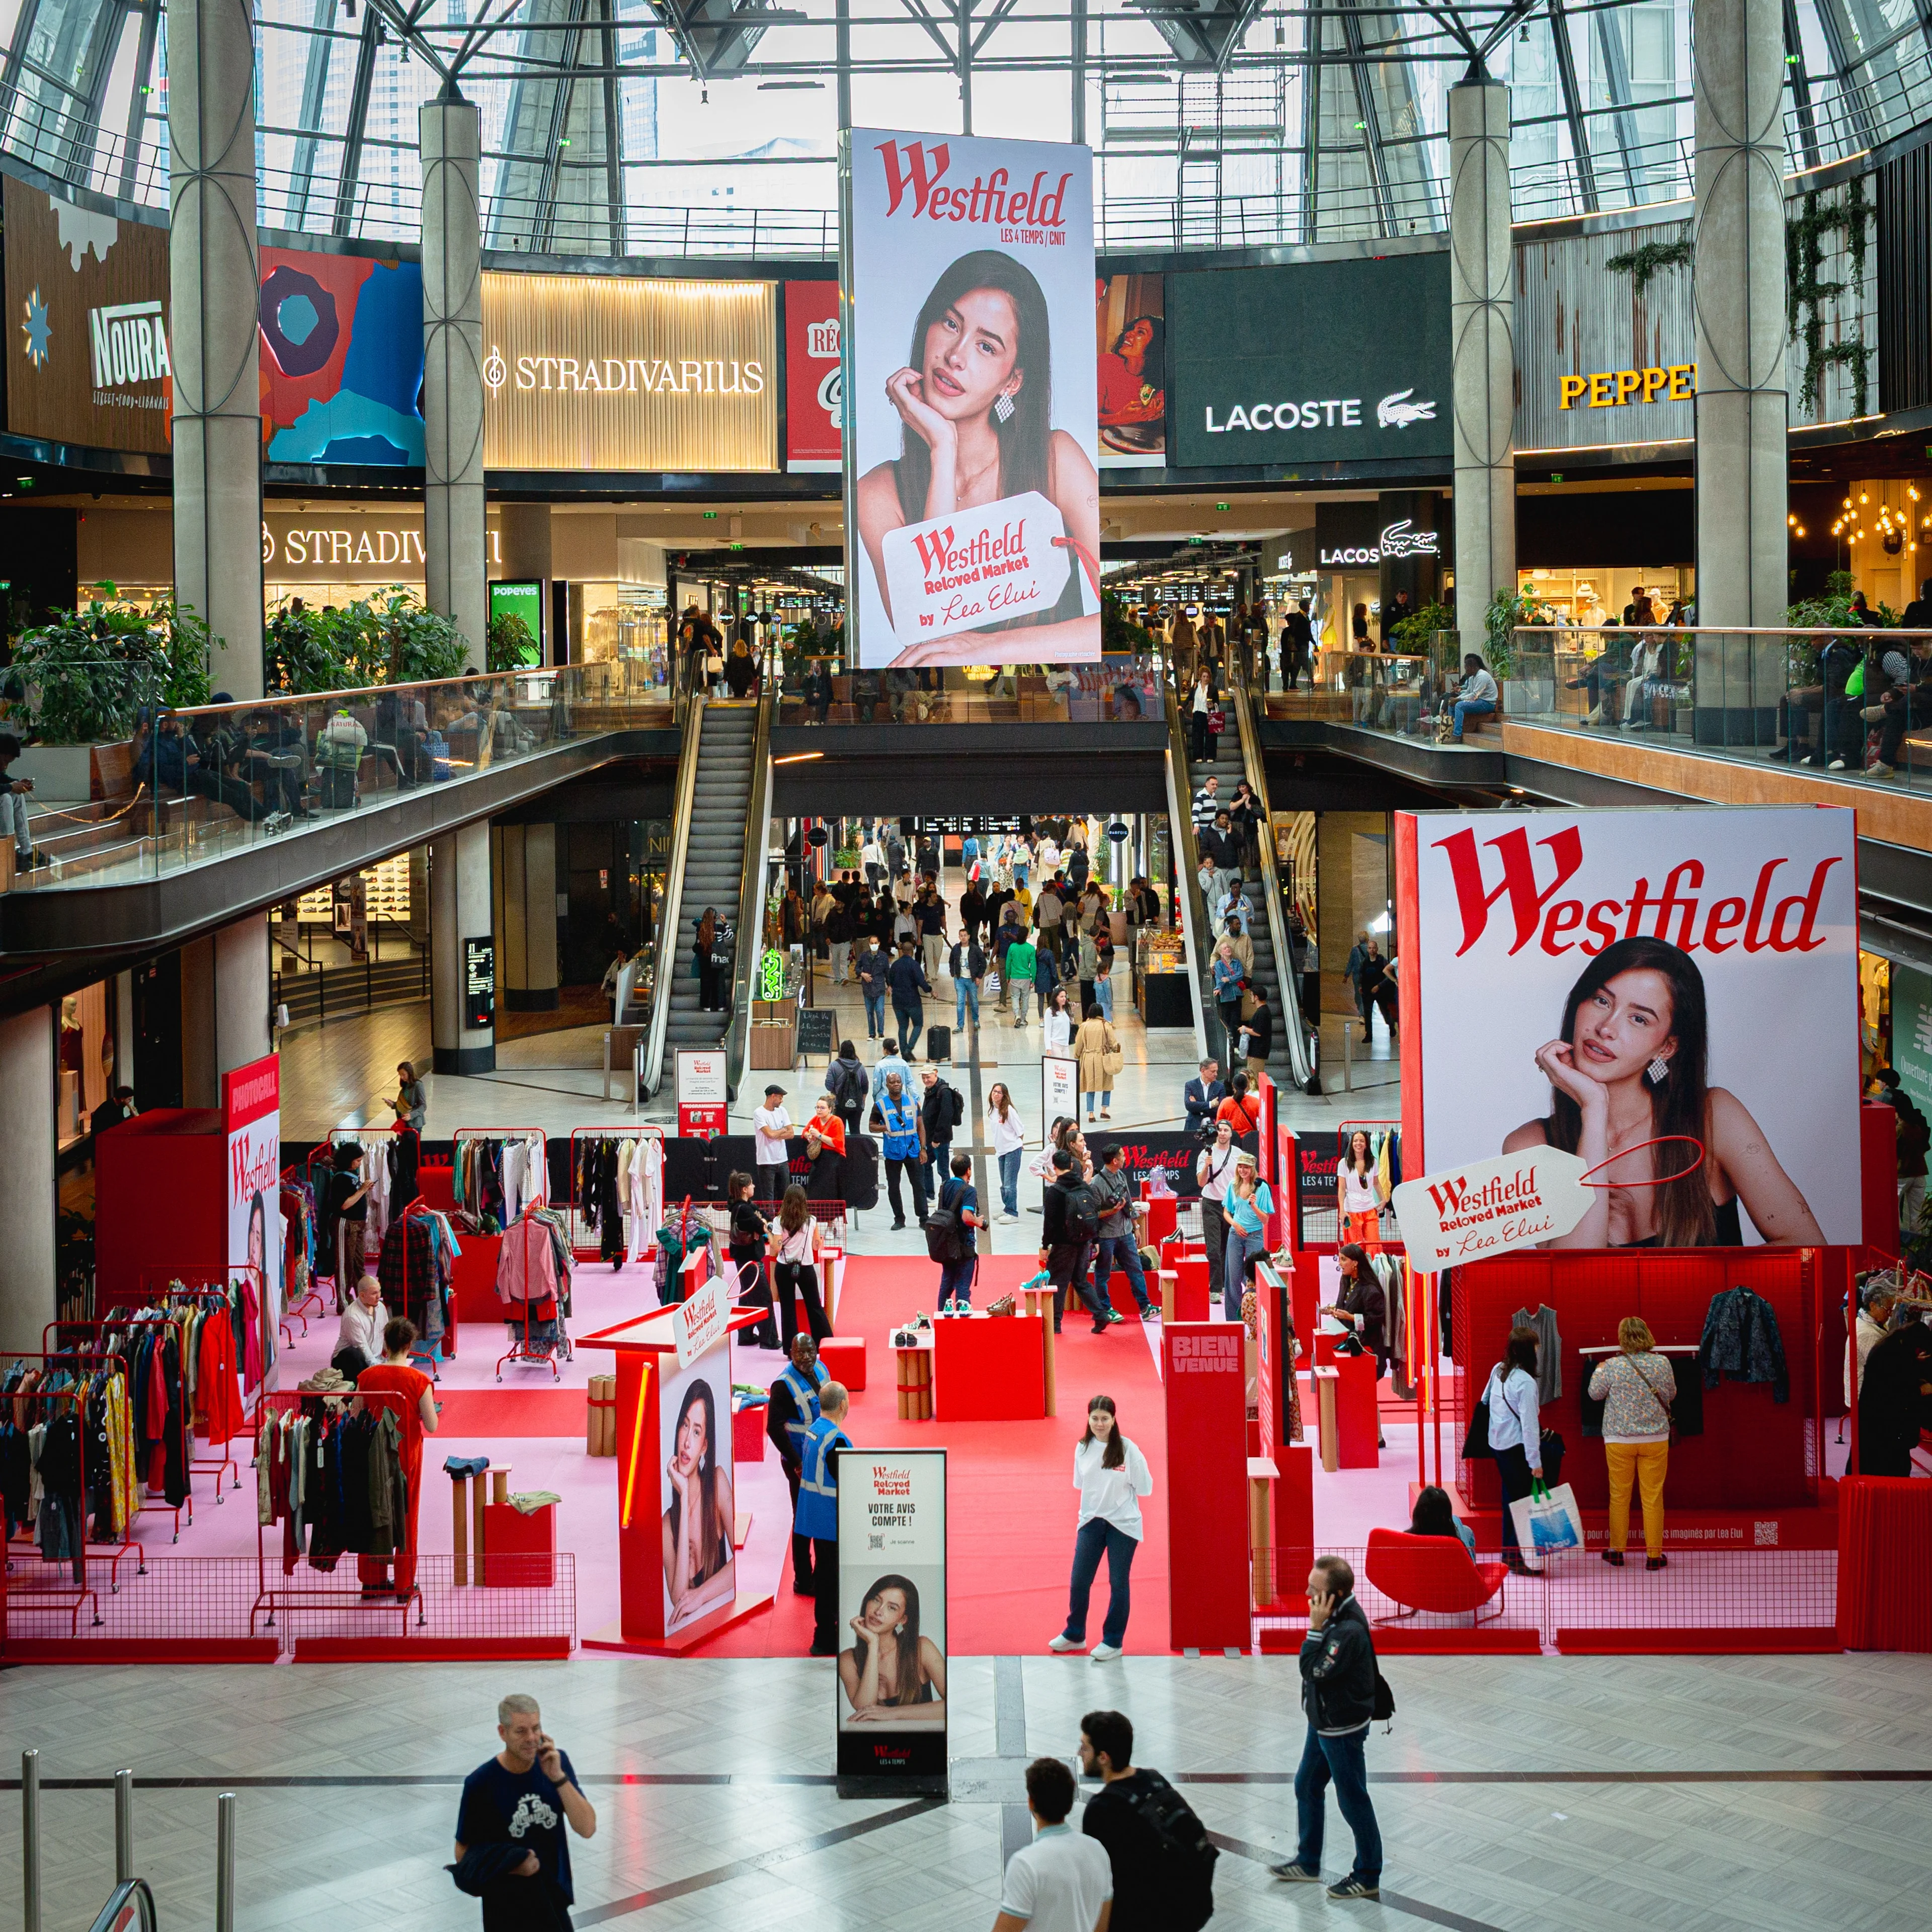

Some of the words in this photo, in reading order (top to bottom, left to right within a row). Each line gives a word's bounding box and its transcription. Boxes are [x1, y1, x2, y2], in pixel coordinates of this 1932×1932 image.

[874, 139, 1074, 227] Westfield
[1001, 228, 1013, 243] LES
[1014, 229, 1019, 244] 4
[1021, 230, 1043, 245] TEMPS
[1050, 231, 1066, 247] CNIT
[92, 300, 172, 388] NOURA
[516, 356, 764, 394] STRADIVARIUS
[1558, 363, 1698, 410] PEPPE
[93, 390, 115, 407] STREET
[118, 394, 135, 409] FOOD
[1205, 399, 1362, 433] LACOSTE
[911, 519, 1026, 578] Westfield
[1321, 548, 1380, 564] LACOS
[924, 572, 981, 595] Reloved
[983, 555, 1029, 580] Market
[920, 612, 934, 627] by
[941, 594, 985, 626] Lea
[988, 580, 1041, 610] Elui
[1154, 587, 1161, 600] 2
[1430, 825, 1843, 957] Westfield
[1901, 1055, 1928, 1084] Ouverture
[232, 1071, 277, 1114] PHOTOCALL
[230, 1131, 279, 1210] Westfield
[1121, 1145, 1192, 1168] Westfield
[791, 1175, 809, 1185] TEM
[1133, 1171, 1147, 1181] LES
[1302, 1176, 1316, 1186] LES
[1318, 1176, 1323, 1186] 4
[1425, 1165, 1539, 1220] Westfield
[1439, 1209, 1494, 1233] Reloved
[1495, 1195, 1542, 1217] Market
[1435, 1247, 1450, 1258] by
[1456, 1230, 1500, 1256] Lea
[1502, 1215, 1555, 1242] Elui
[683, 1290, 715, 1332] Westfield
[688, 1321, 703, 1340] Reloved
[703, 1309, 717, 1326] Market
[1172, 1336, 1238, 1357] BIEN
[1173, 1357, 1239, 1373] VENUE
[872, 1466, 911, 1479] Westfield
[868, 1503, 894, 1514] VOTRE
[897, 1503, 916, 1514] AVIS
[872, 1516, 906, 1526] COMPTE
[1587, 1530, 1603, 1540] pour
[1670, 1527, 1703, 1540] imaginés
[1704, 1528, 1716, 1540] par
[1717, 1527, 1729, 1539] Lea
[1730, 1527, 1743, 1539] Elui
[874, 1745, 911, 1758] Westfield
